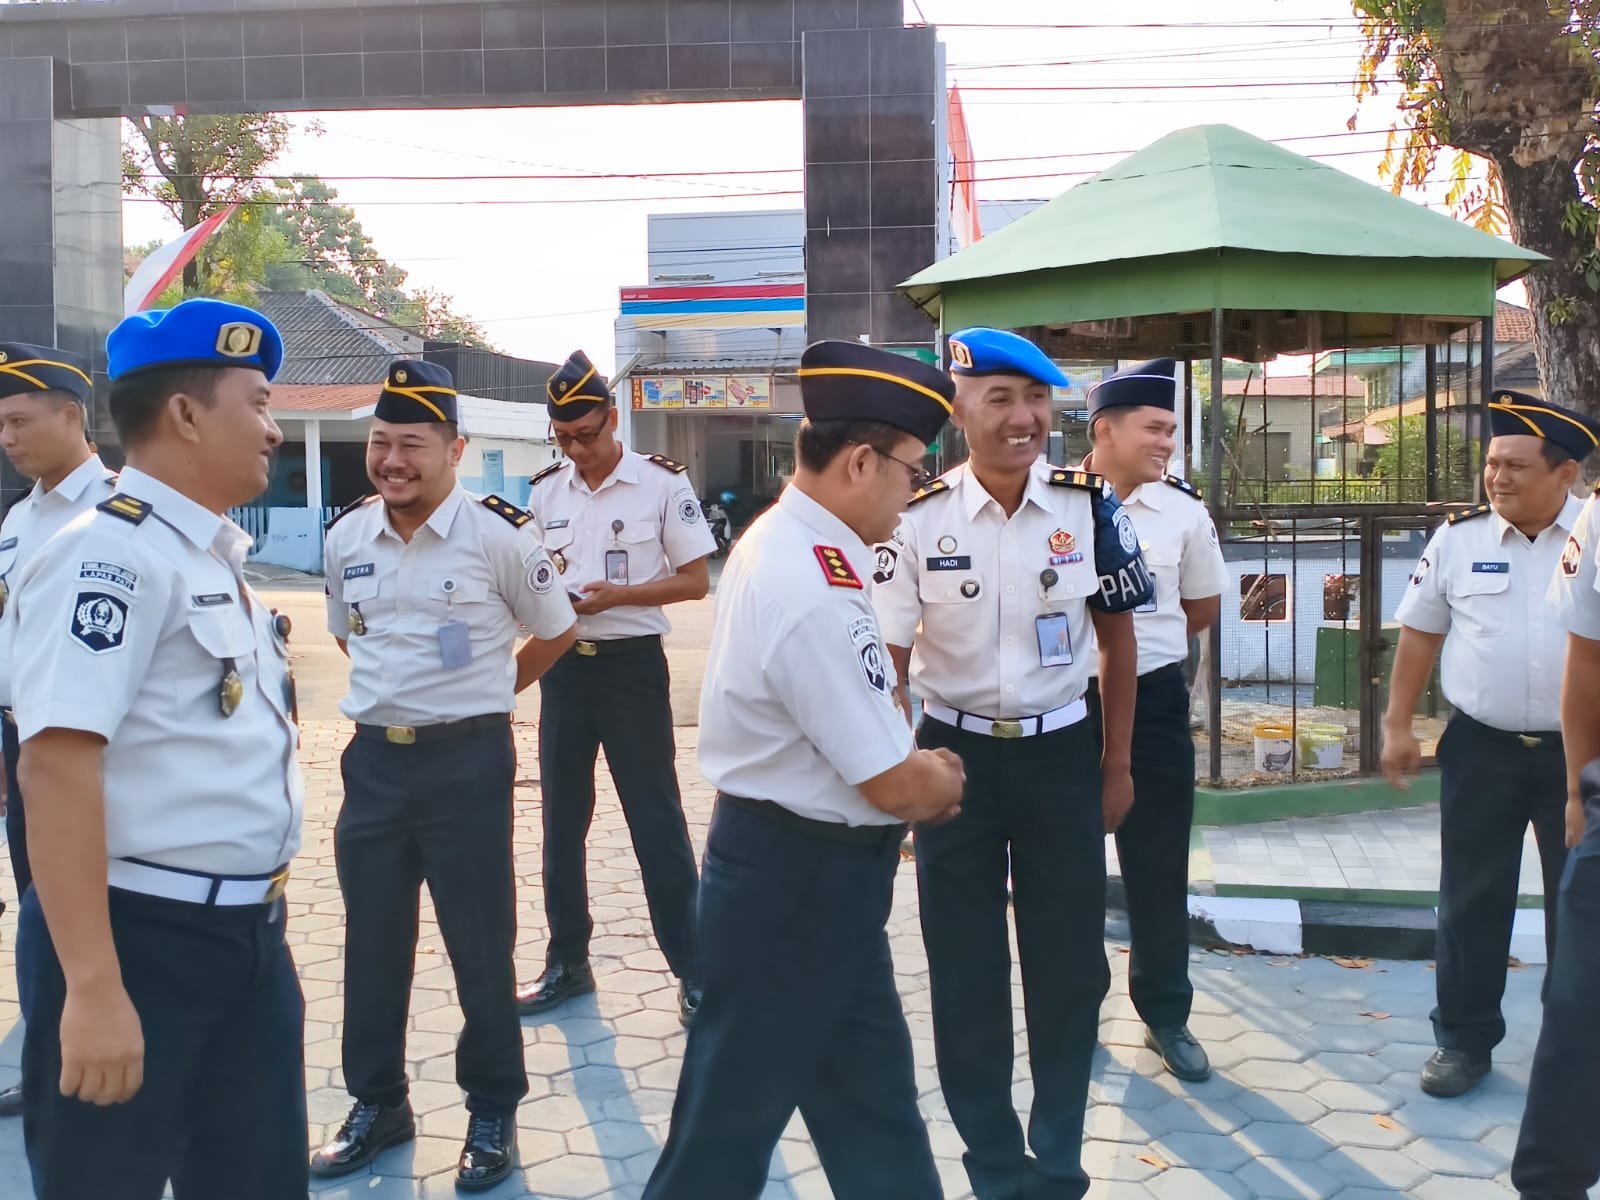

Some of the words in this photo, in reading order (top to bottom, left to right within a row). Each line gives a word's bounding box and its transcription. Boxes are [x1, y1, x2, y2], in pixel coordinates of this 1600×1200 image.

[633, 378, 641, 409] HEMAT
[346, 565, 370, 576] PUTRA
[939, 559, 958, 568] HADI
[83, 570, 113, 581] LAPAS
[113, 576, 132, 589] PATI
